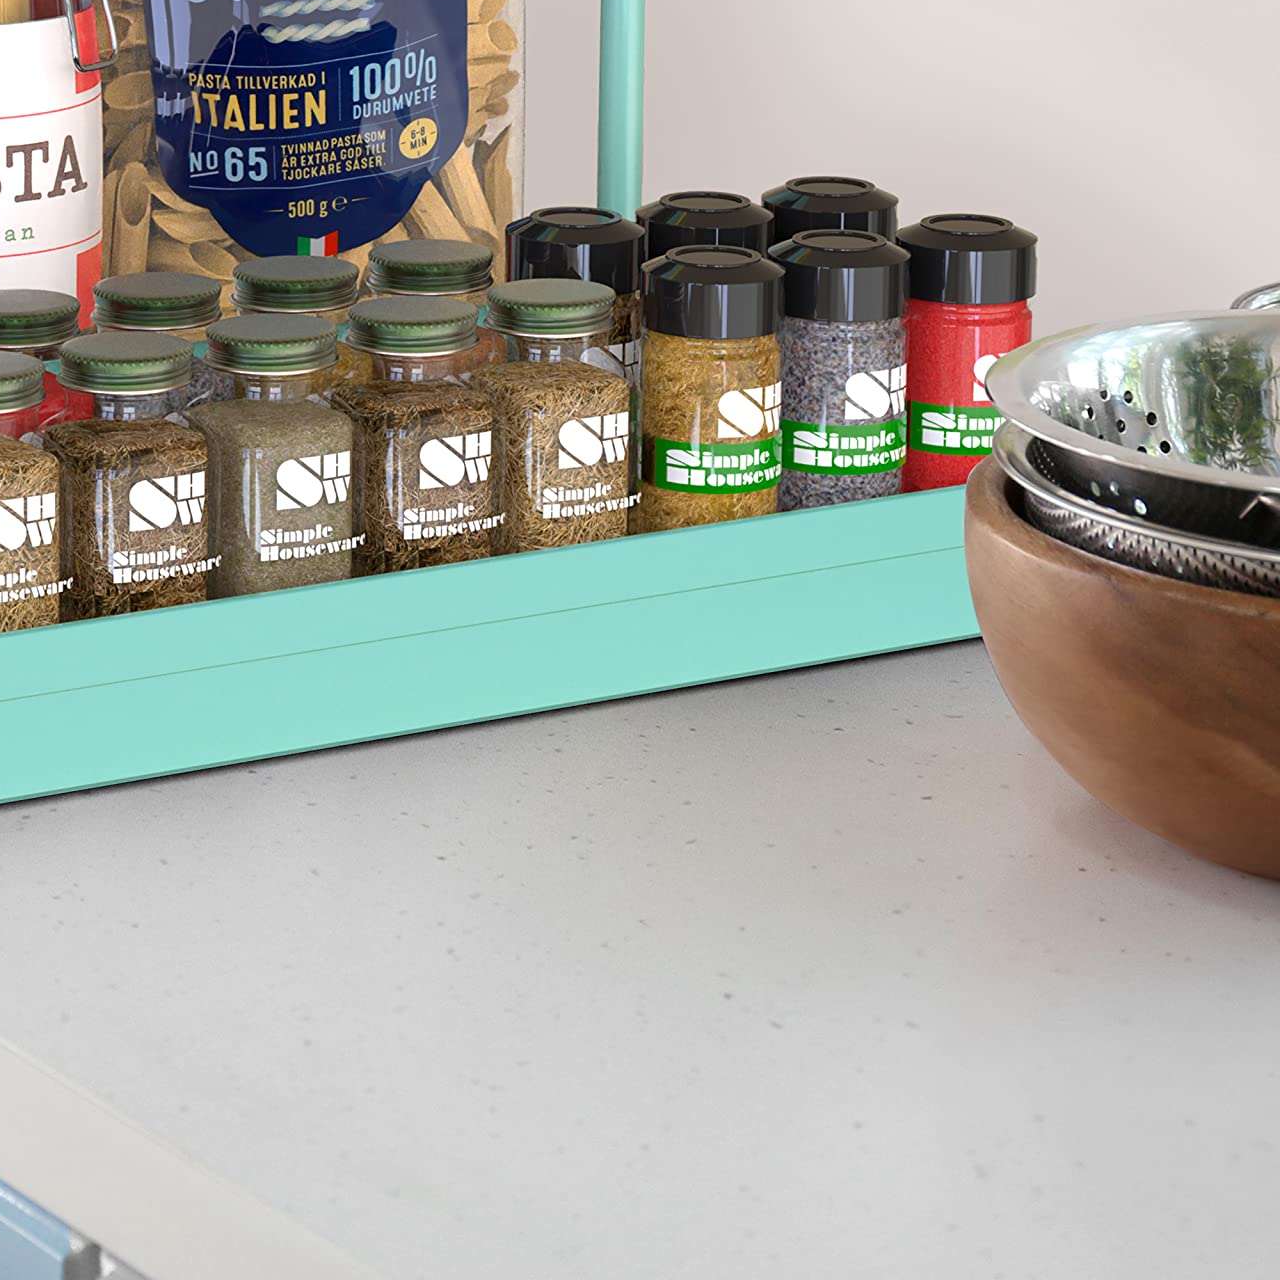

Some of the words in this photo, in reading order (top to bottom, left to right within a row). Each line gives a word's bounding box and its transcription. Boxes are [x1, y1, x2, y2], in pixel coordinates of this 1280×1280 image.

[188, 72, 231, 89] PASTA
[235, 73, 317, 91] TILLVERKAD
[321, 71, 326, 86] I
[349, 47, 437, 102] 100%
[192, 89, 327, 132] ITALIEN
[352, 84, 437, 120] DURUMVETE
[281, 139, 330, 155] TVINNAD
[331, 134, 363, 149] PASTA
[364, 129, 386, 143] SOM
[410, 126, 426, 139] 6-8
[281, 154, 297, 168] ÄR
[300, 151, 337, 167] EXTRA
[340, 146, 362, 159] GOD
[365, 142, 386, 156] TILL
[410, 138, 428, 150] MIN
[189, 150, 219, 173] NO
[223, 146, 268, 182] 65
[281, 164, 342, 181] TJOCKARE
[288, 198, 315, 219] 500
[319, 201, 328, 218] g
[793, 429, 896, 451] Simple
[666, 448, 770, 471] Simple
[542, 482, 612, 503] Simple
[403, 502, 475, 524] Simple
[260, 523, 334, 545] Simple
[112, 545, 188, 568] Simple
